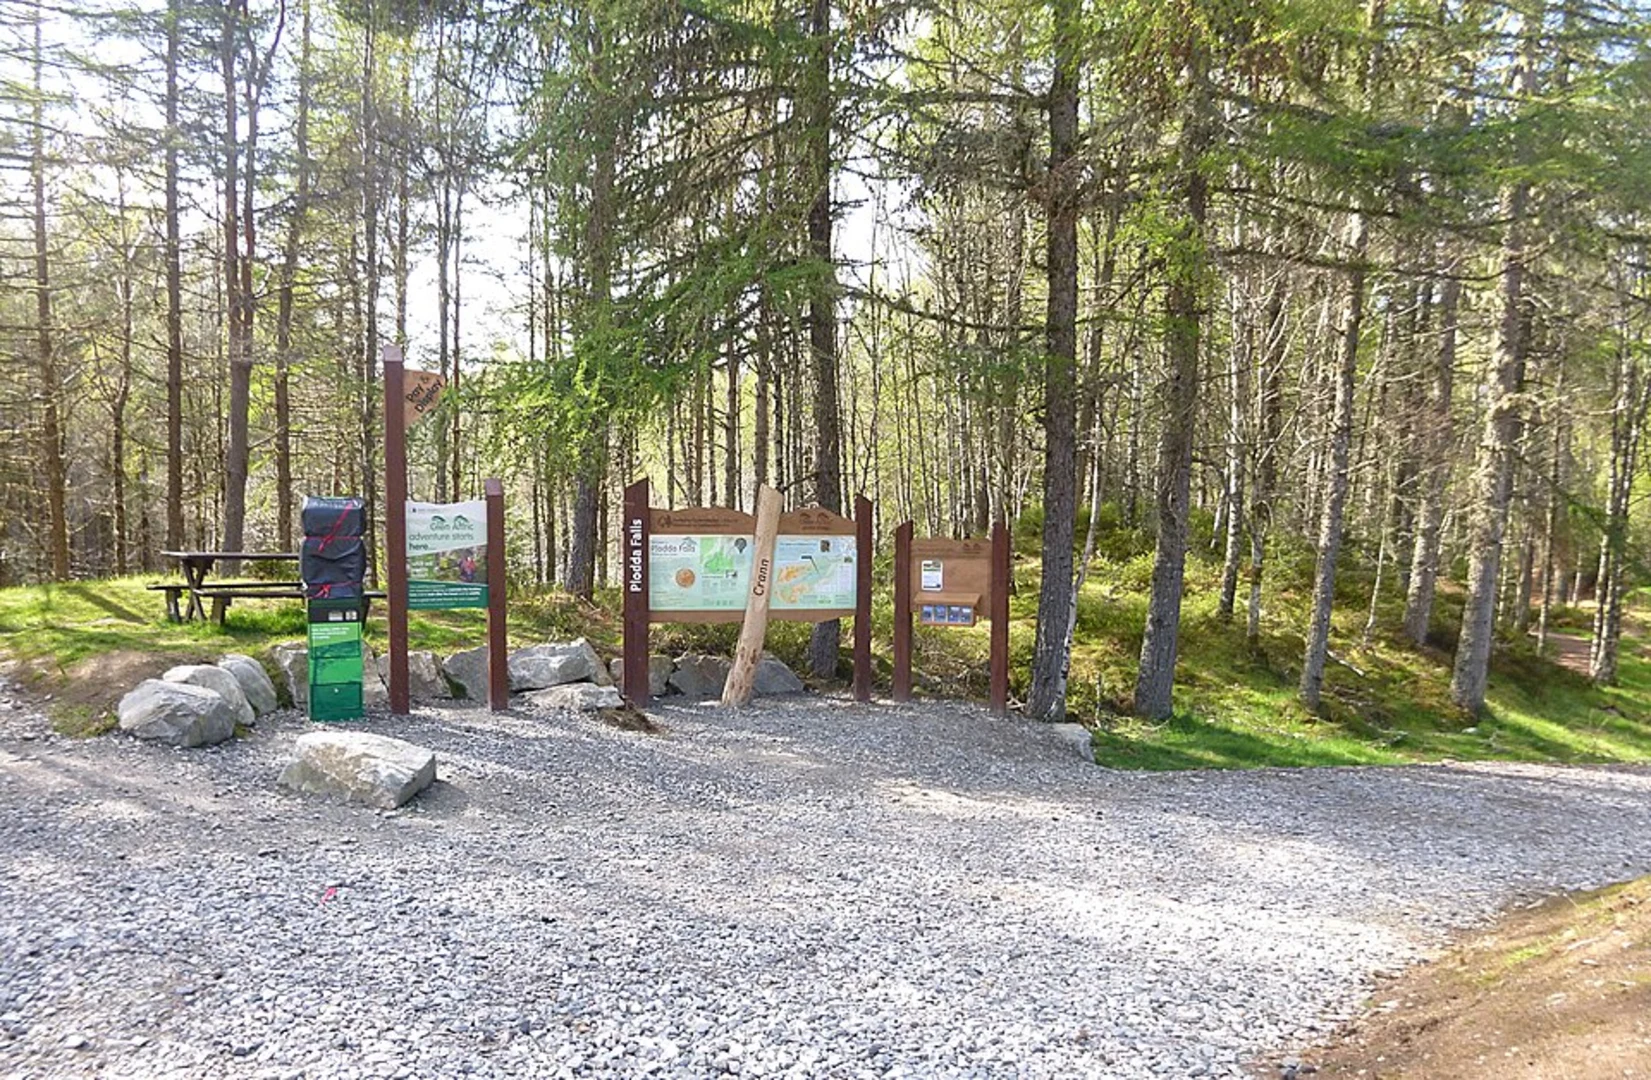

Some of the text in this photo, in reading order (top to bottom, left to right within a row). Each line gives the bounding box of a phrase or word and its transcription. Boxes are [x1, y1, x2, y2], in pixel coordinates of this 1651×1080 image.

[405, 383, 425, 402] Pay
[414, 379, 443, 413] Display
[429, 521, 474, 531] Glen Affric
[408, 533, 474, 541] adventure starts
[629, 519, 642, 592] Plodda Falls
[651, 544, 696, 553] Plodda Falls
[752, 558, 770, 596] Crann
